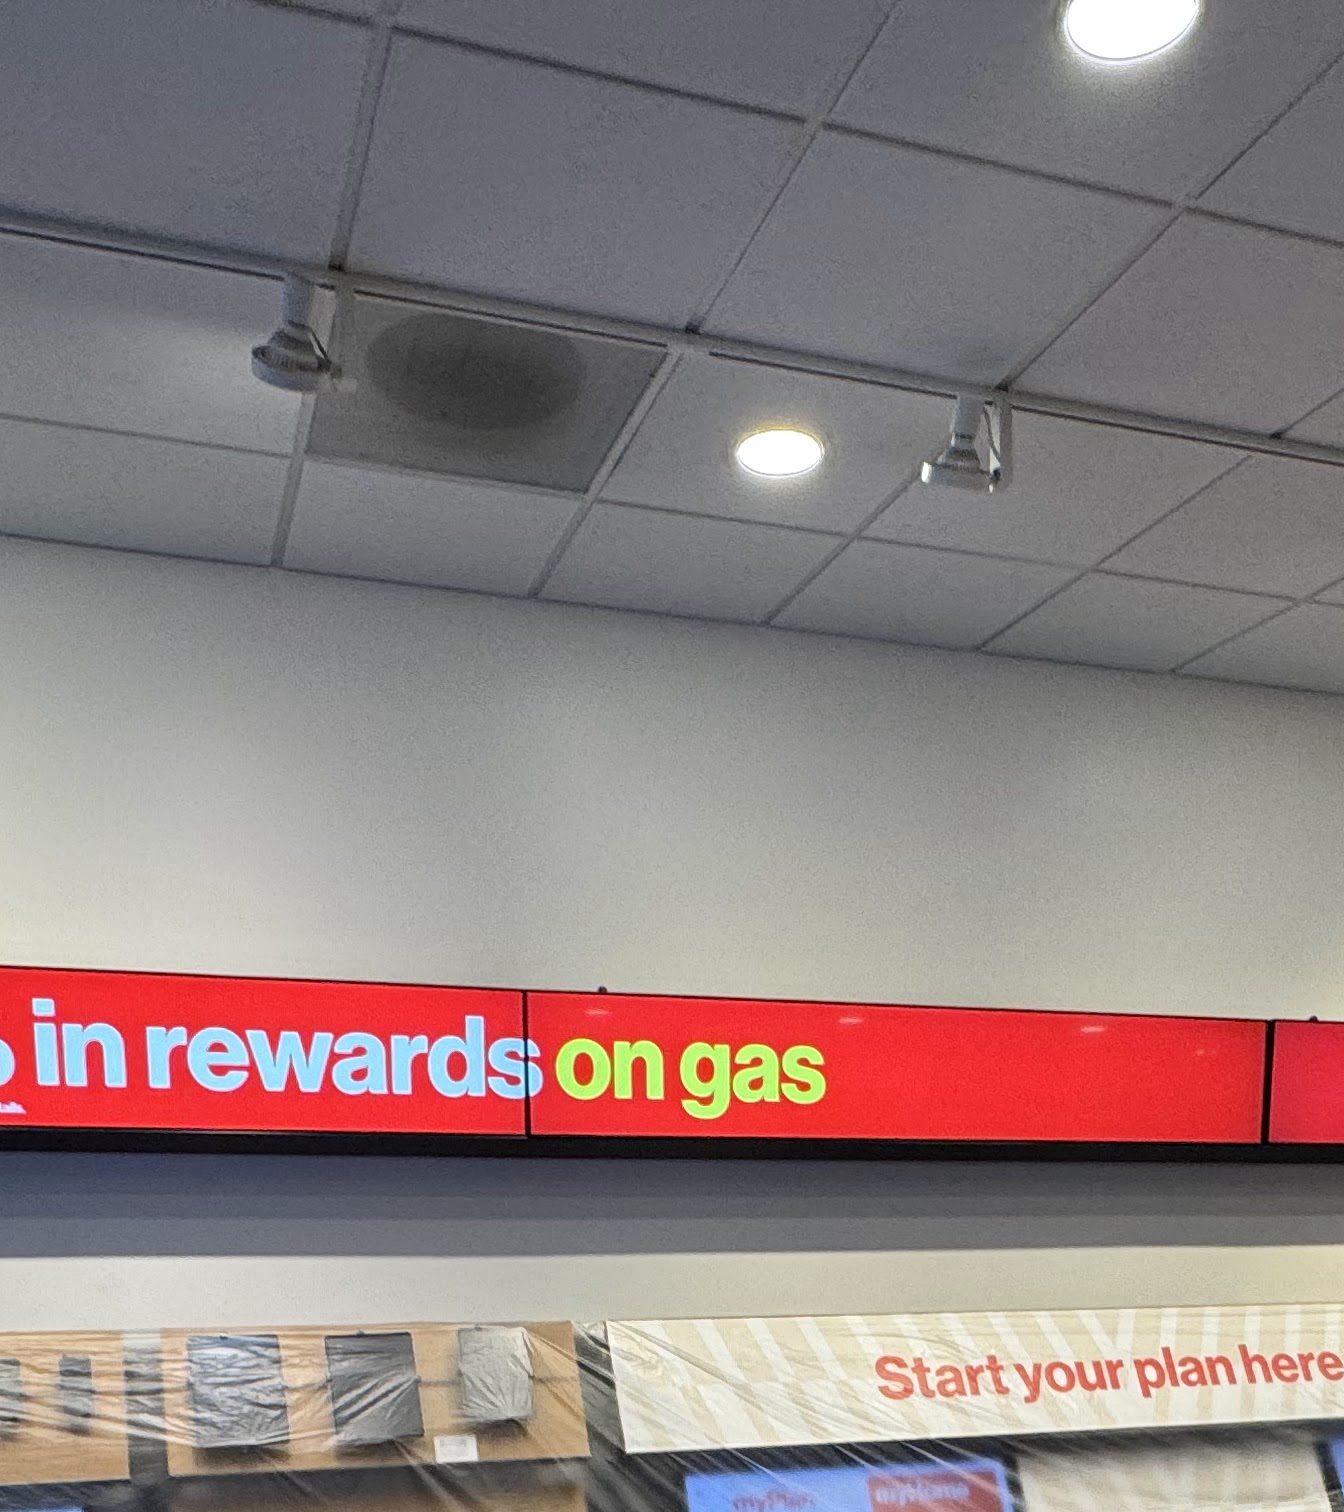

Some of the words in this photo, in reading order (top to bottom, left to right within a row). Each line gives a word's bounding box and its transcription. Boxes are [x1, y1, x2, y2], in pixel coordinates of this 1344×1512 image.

[31, 998, 127, 1088] in
[146, 1015, 544, 1099] rewards
[555, 1038, 665, 1100] on
[679, 1041, 827, 1120] gas
[875, 1354, 1010, 1401] Start
[1012, 1357, 1124, 1404] your
[1133, 1346, 1237, 1398] plan
